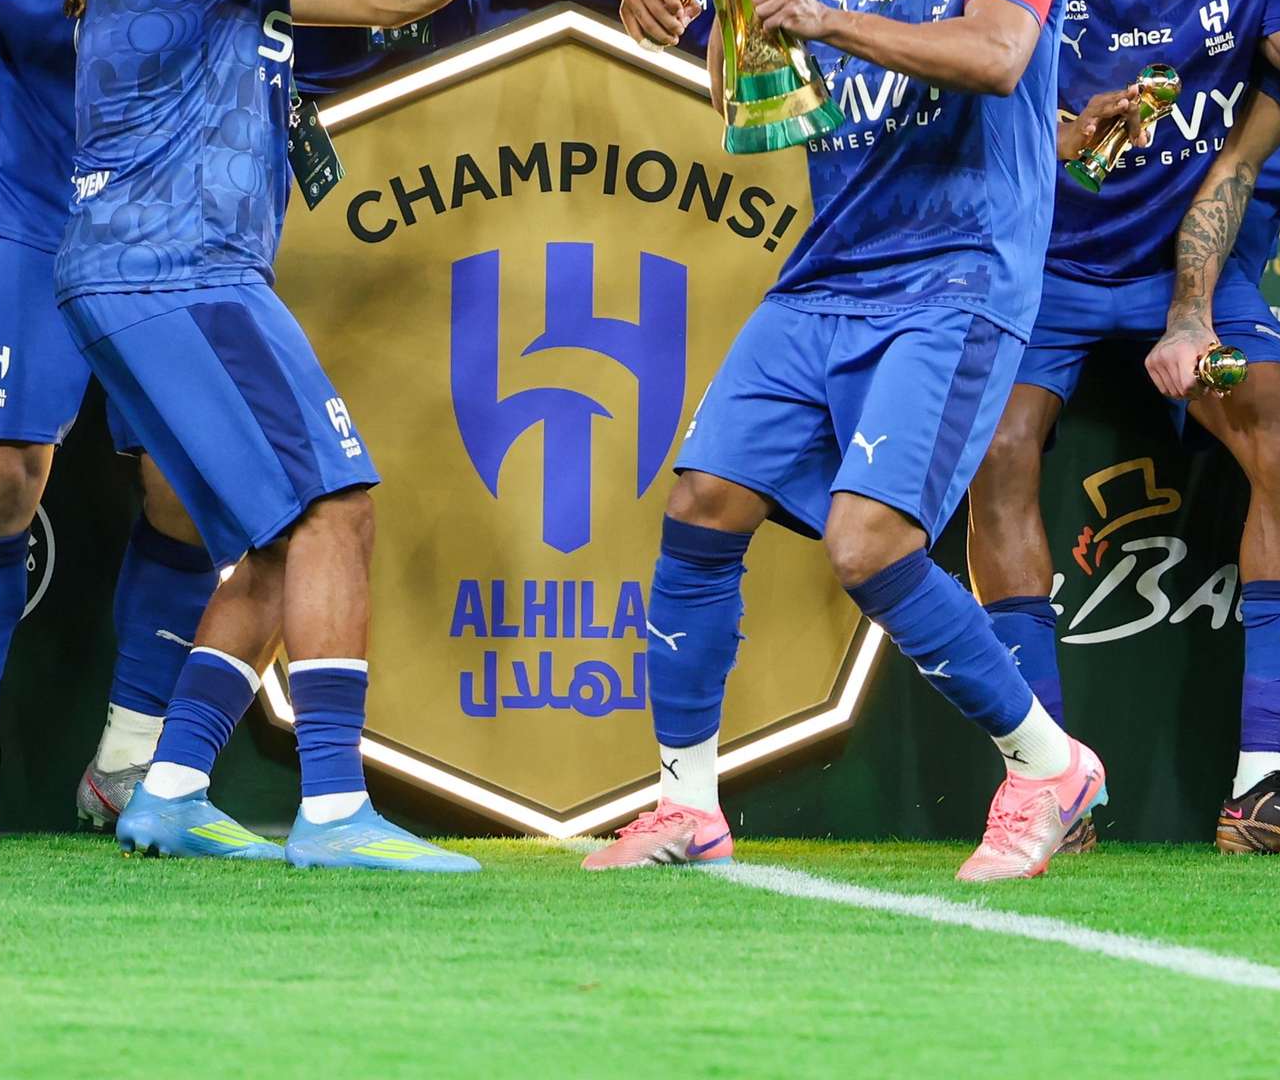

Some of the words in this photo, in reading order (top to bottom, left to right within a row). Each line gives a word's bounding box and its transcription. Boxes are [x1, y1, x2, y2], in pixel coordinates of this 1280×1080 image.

[1108, 28, 1173, 52] Jahez
[809, 131, 875, 153] GAMES
[1160, 137, 1225, 165] GROU
[346, 142, 798, 252] CHAMPIONS!
[450, 580, 649, 638] ALHILA
[459, 651, 648, 718] لهلال
